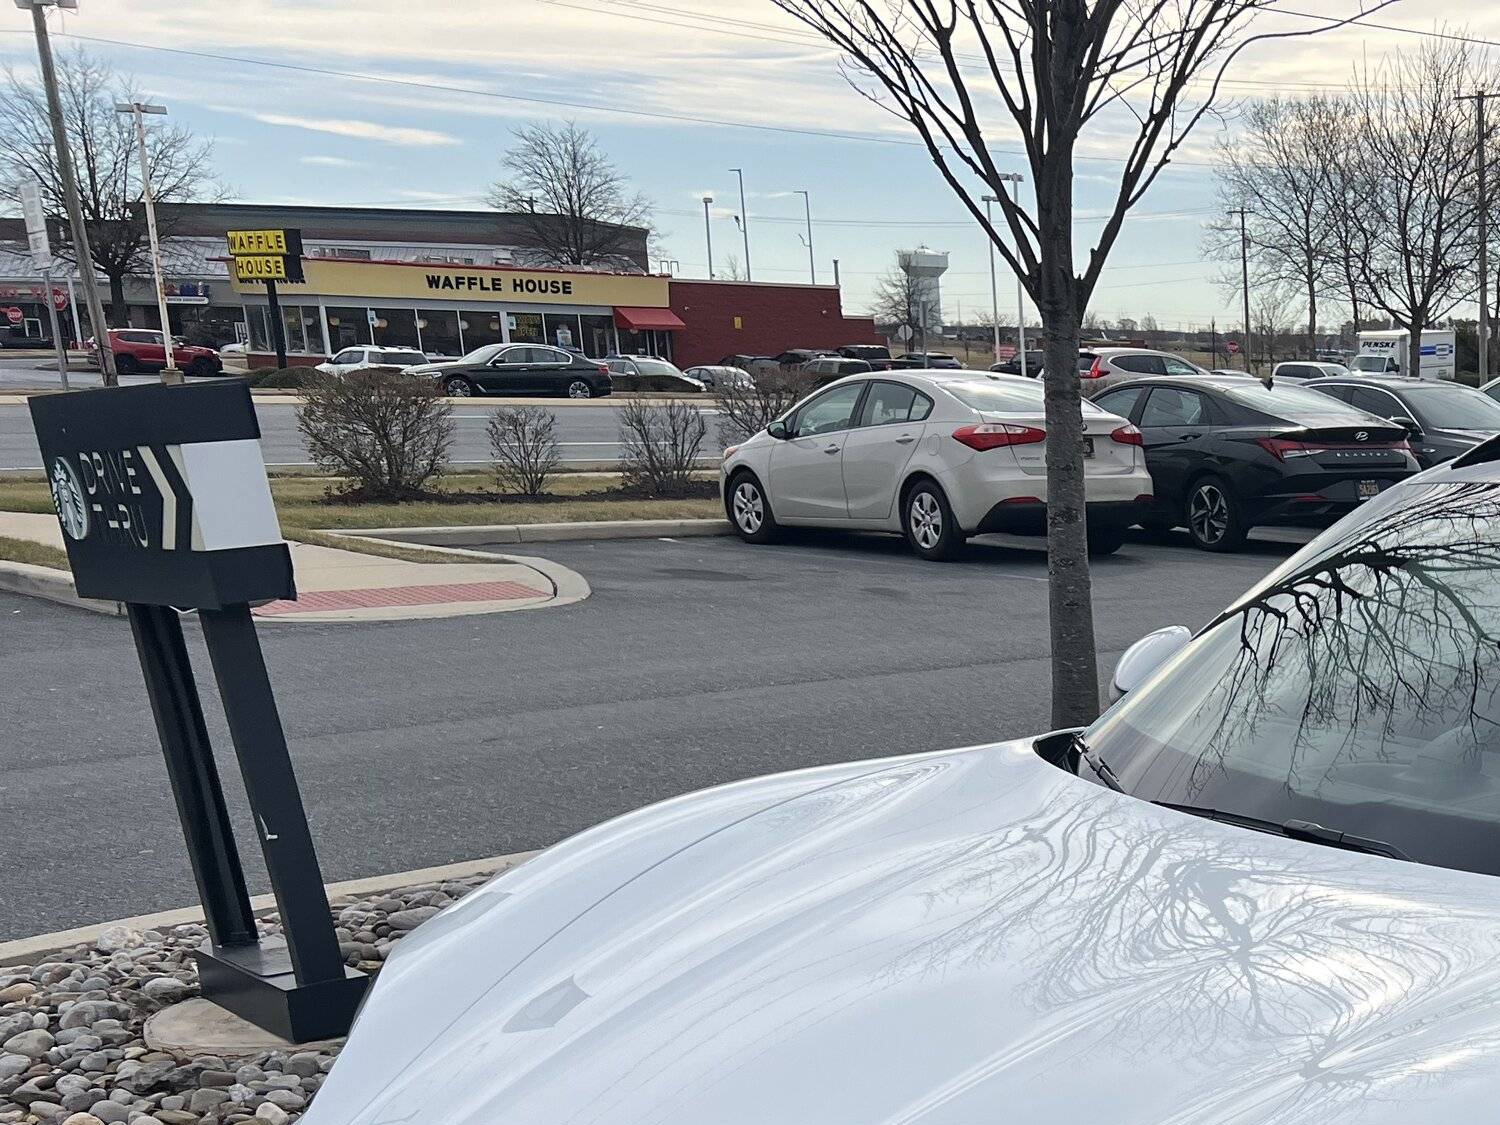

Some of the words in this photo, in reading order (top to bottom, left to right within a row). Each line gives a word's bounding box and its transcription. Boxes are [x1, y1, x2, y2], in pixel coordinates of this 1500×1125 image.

[229, 234, 283, 250] WAFFLE
[237, 260, 283, 275] HOUSE
[425, 274, 502, 292] WAFFLE
[513, 278, 572, 295] HOUSE
[79, 450, 141, 495] DRIVE
[92, 503, 149, 548] THRU
